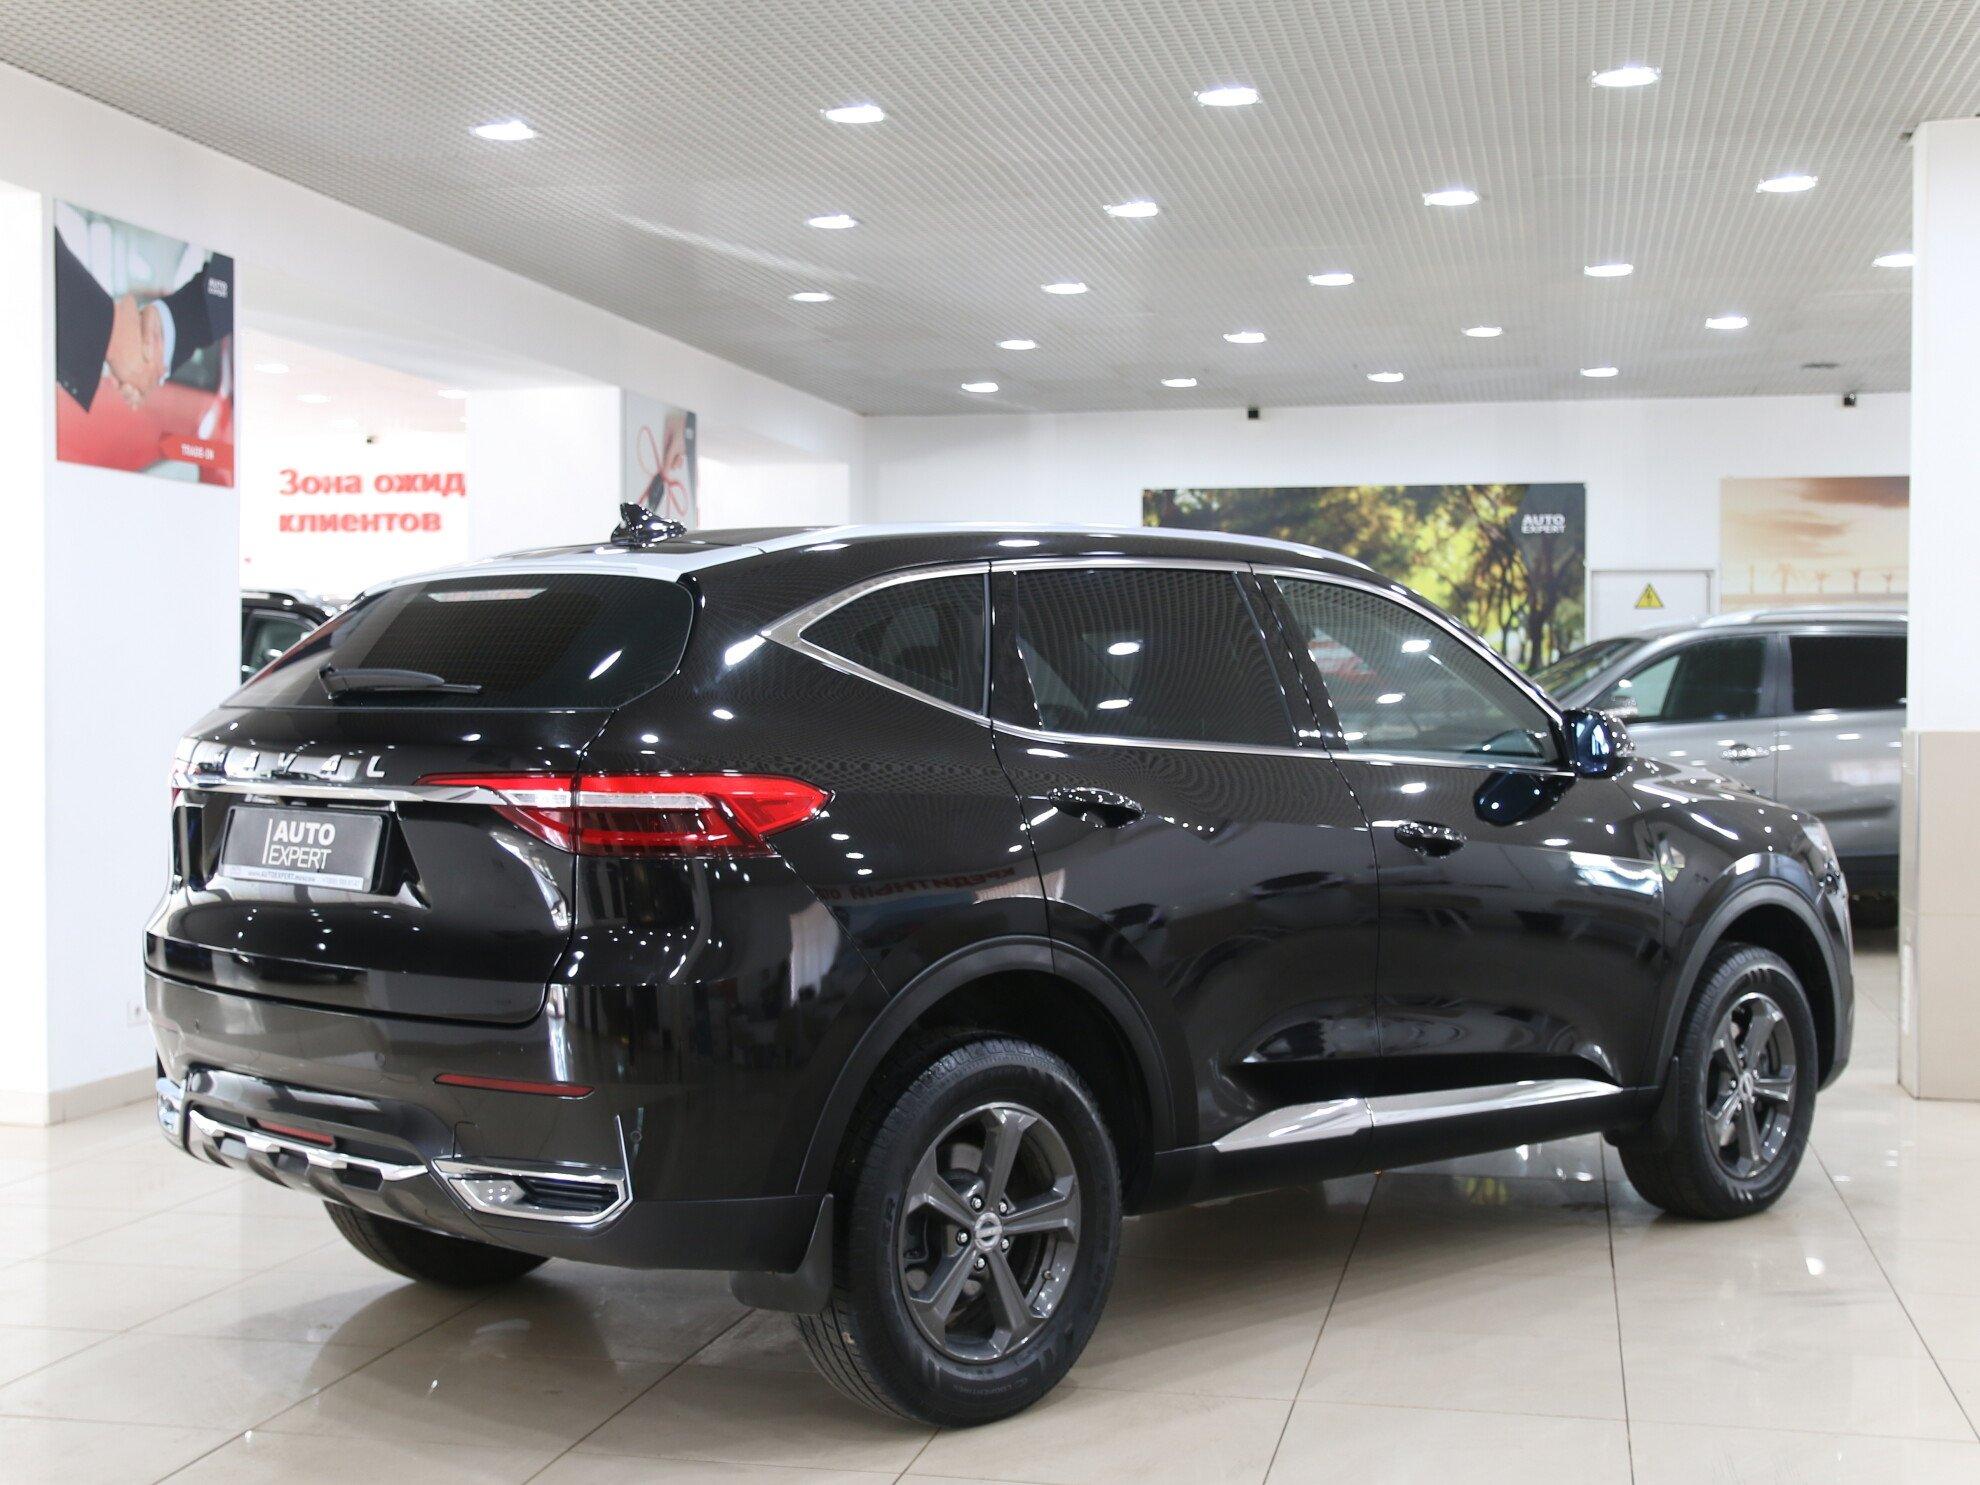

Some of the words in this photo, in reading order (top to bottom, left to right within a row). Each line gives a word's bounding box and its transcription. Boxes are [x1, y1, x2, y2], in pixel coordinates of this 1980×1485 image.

[279, 468, 362, 496] Зона
[374, 472, 466, 497] ожид
[279, 511, 441, 533] клиентов
[1522, 513, 1566, 526] AUTO
[273, 820, 336, 846] AUTO
[268, 845, 332, 870] EXPERT
